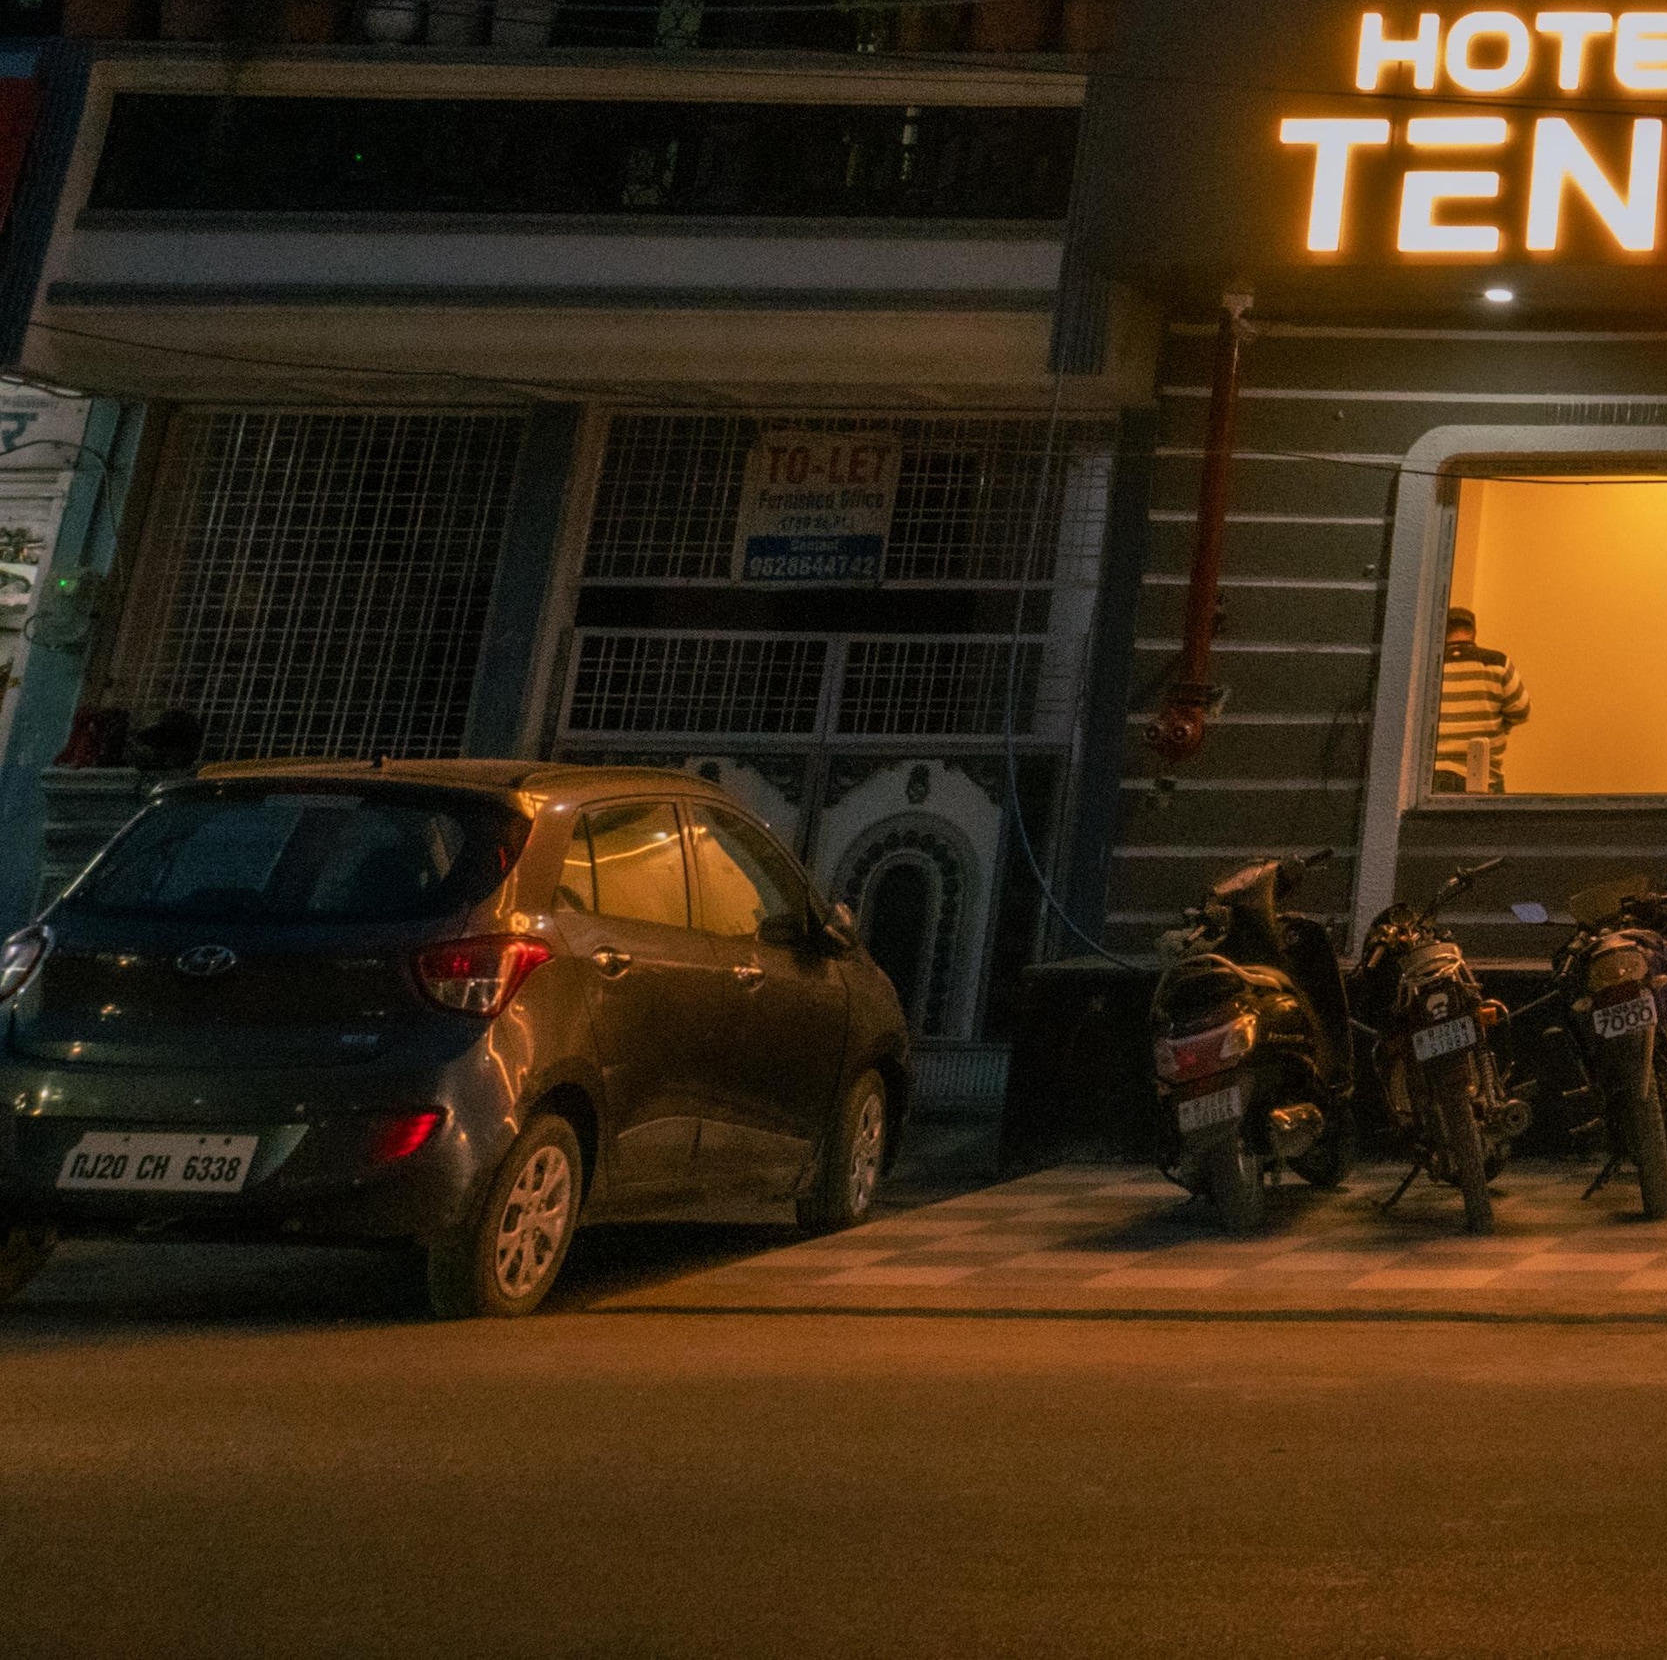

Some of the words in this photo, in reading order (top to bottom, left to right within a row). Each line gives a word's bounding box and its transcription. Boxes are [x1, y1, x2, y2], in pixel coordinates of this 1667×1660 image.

[1279, 116, 1663, 253] TEN
[768, 446, 890, 484] TO-LET
[1598, 1006, 1653, 1036] 7000
[70, 1153, 129, 1179] RJ20
[136, 1154, 171, 1179] CH
[183, 1155, 243, 1183] 6338
